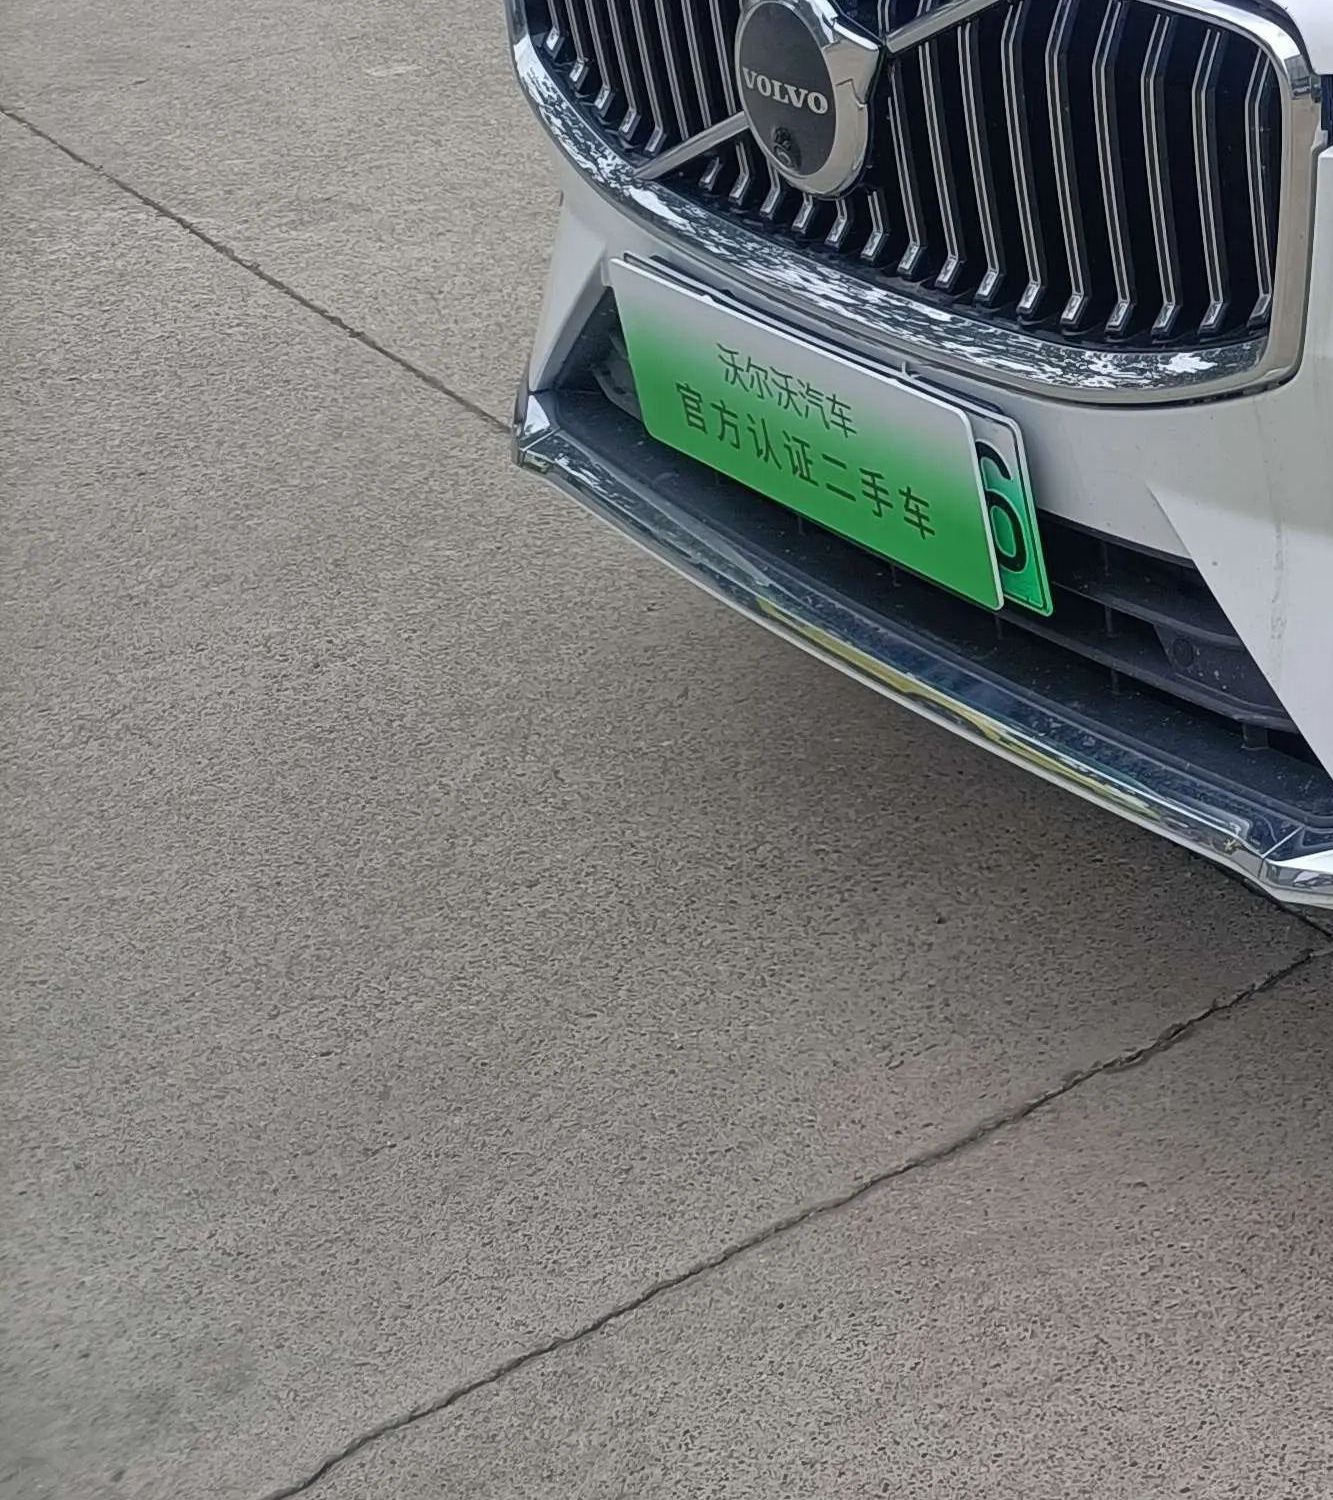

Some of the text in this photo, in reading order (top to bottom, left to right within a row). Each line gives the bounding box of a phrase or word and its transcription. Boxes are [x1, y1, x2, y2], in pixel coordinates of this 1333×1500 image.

[742, 67, 829, 115] VOLVO
[716, 342, 858, 439] 沃尔沃汽车
[675, 382, 936, 541] 官方认证二手车
